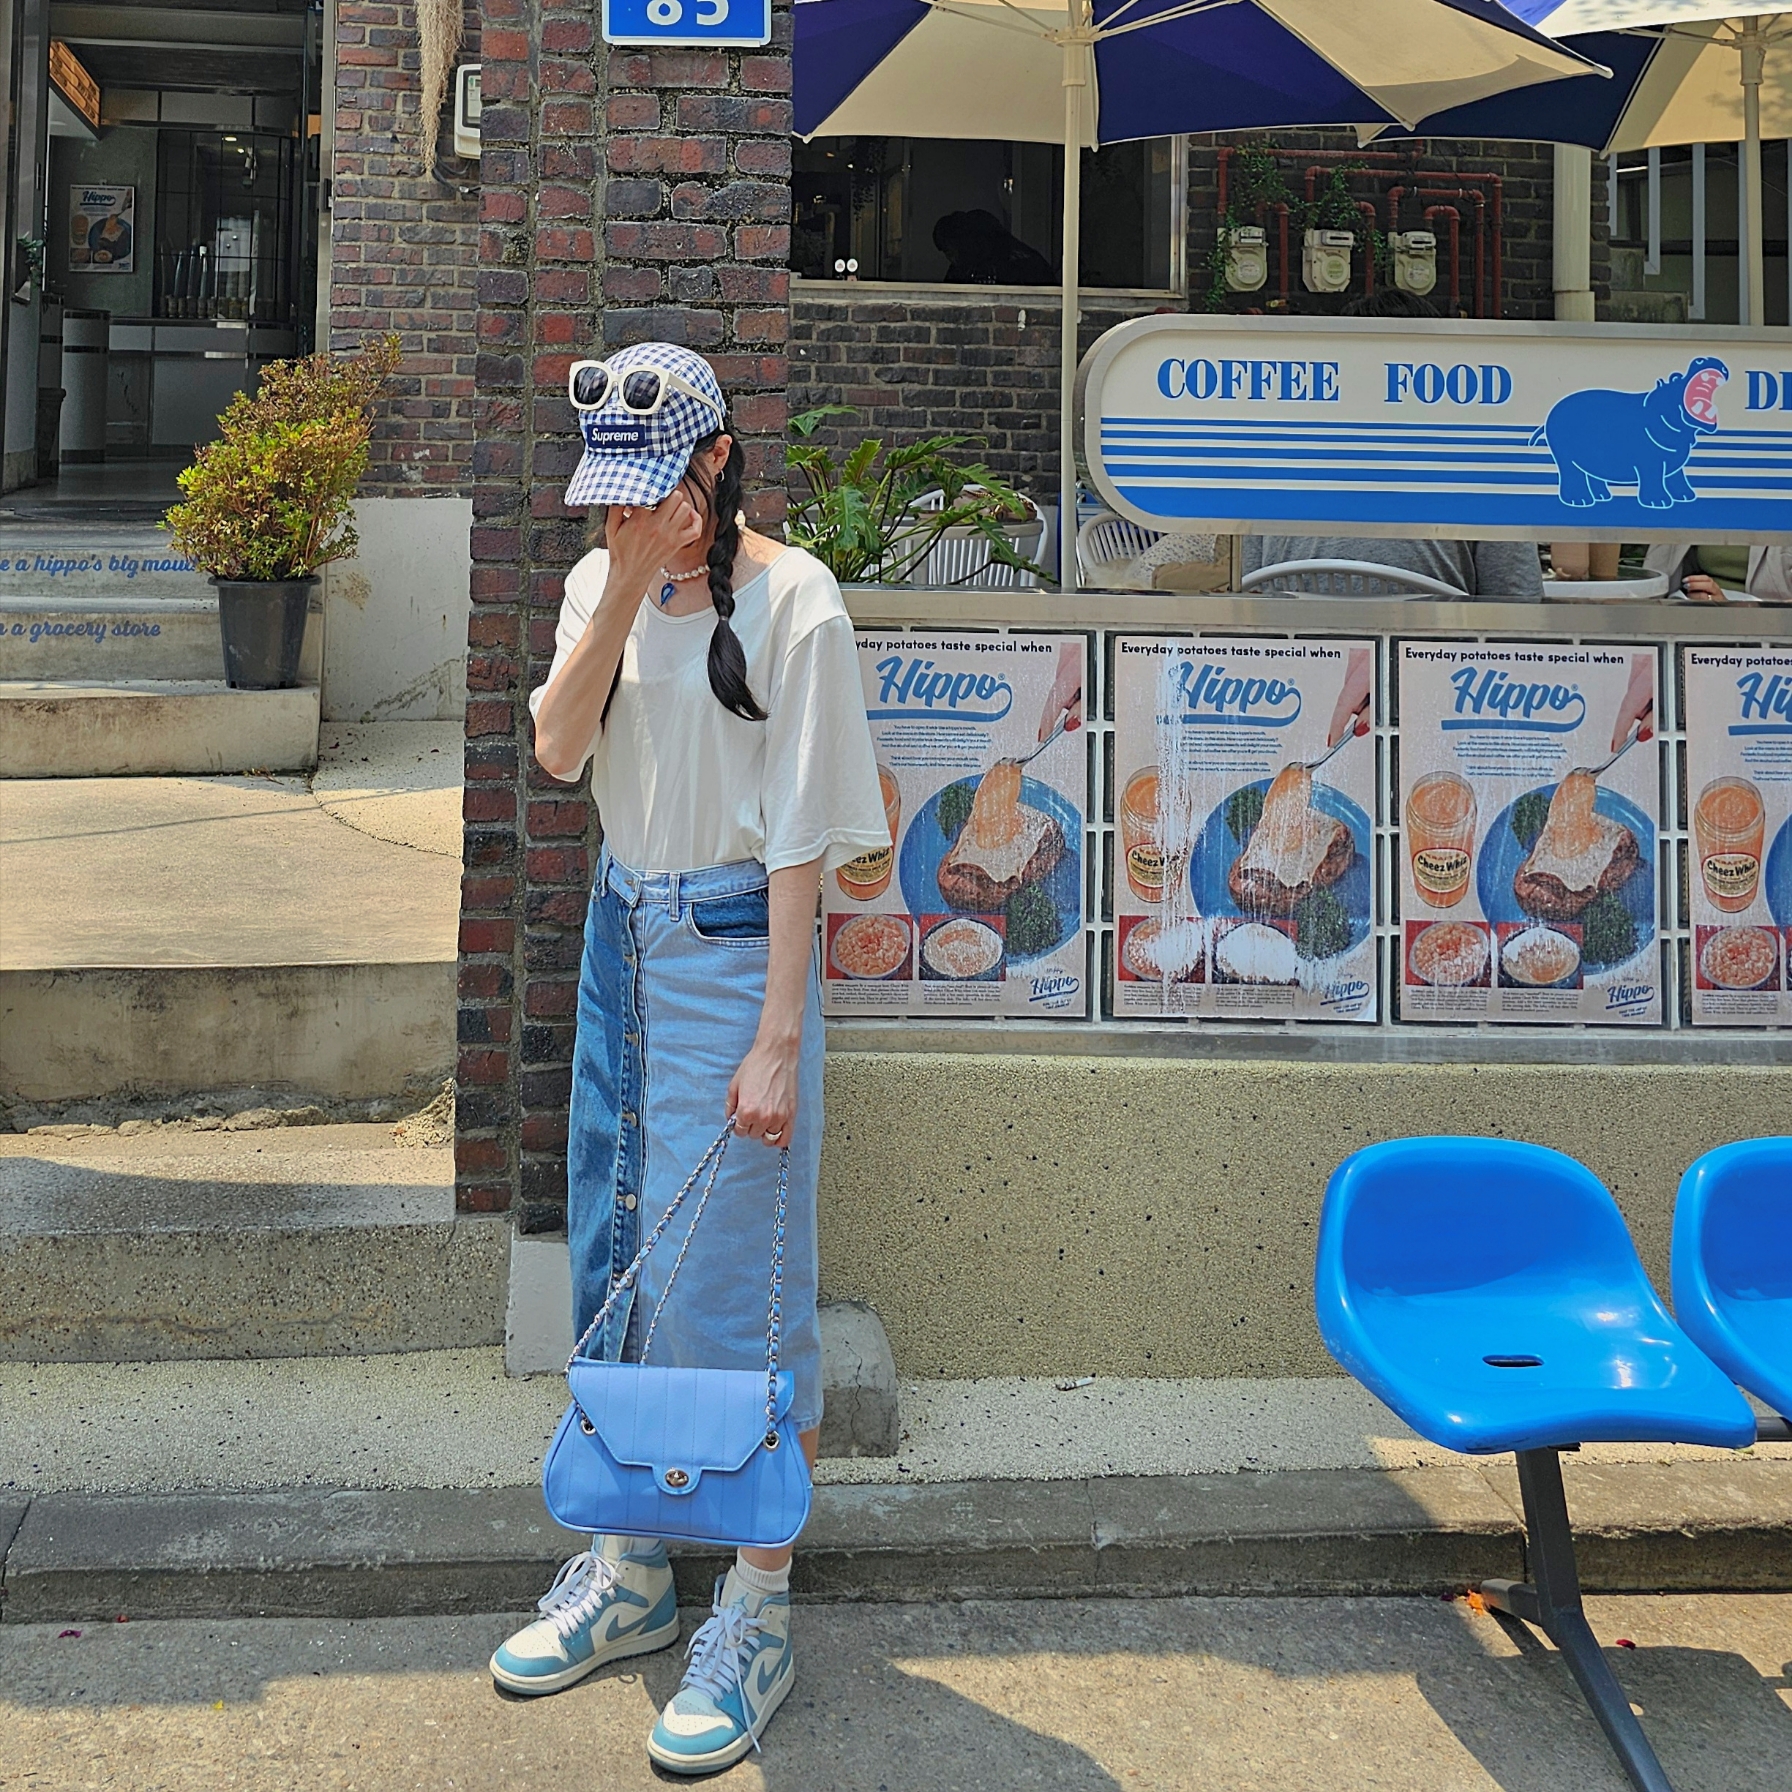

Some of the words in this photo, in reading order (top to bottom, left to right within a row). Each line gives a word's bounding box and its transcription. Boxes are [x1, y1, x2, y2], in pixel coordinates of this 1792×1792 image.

[1157, 358, 1340, 402] COFFEE
[1384, 363, 1513, 405] FOOD
[591, 428, 638, 445] Supreme
[15, 558, 31, 572] a
[33, 553, 103, 578] hippo's
[108, 554, 140, 579] big
[141, 556, 197, 572] mou
[11, 622, 27, 636] a
[29, 621, 108, 644] grocery
[111, 620, 162, 637] store
[886, 639, 938, 652] potatoes
[941, 640, 971, 652] taste
[975, 641, 1017, 653] special
[1020, 643, 1053, 653] when
[1121, 642, 1174, 657] Everyday
[1177, 644, 1228, 657] potatoes
[1231, 645, 1261, 657] taste
[1264, 645, 1307, 658] special
[1310, 647, 1342, 659] when
[1405, 647, 1458, 662] Everyday
[1460, 650, 1512, 662] potatoes
[1514, 651, 1545, 662] taste
[1548, 652, 1590, 664] special
[1593, 653, 1625, 664] when
[1691, 653, 1743, 668] Everyday
[875, 655, 1012, 712] Hippo
[1450, 666, 1586, 720] Hippo
[1131, 850, 1159, 867] Cheez
[1417, 855, 1446, 872] Cheez
[1706, 860, 1735, 877] Cheez
[1607, 984, 1655, 1004] Hippo
